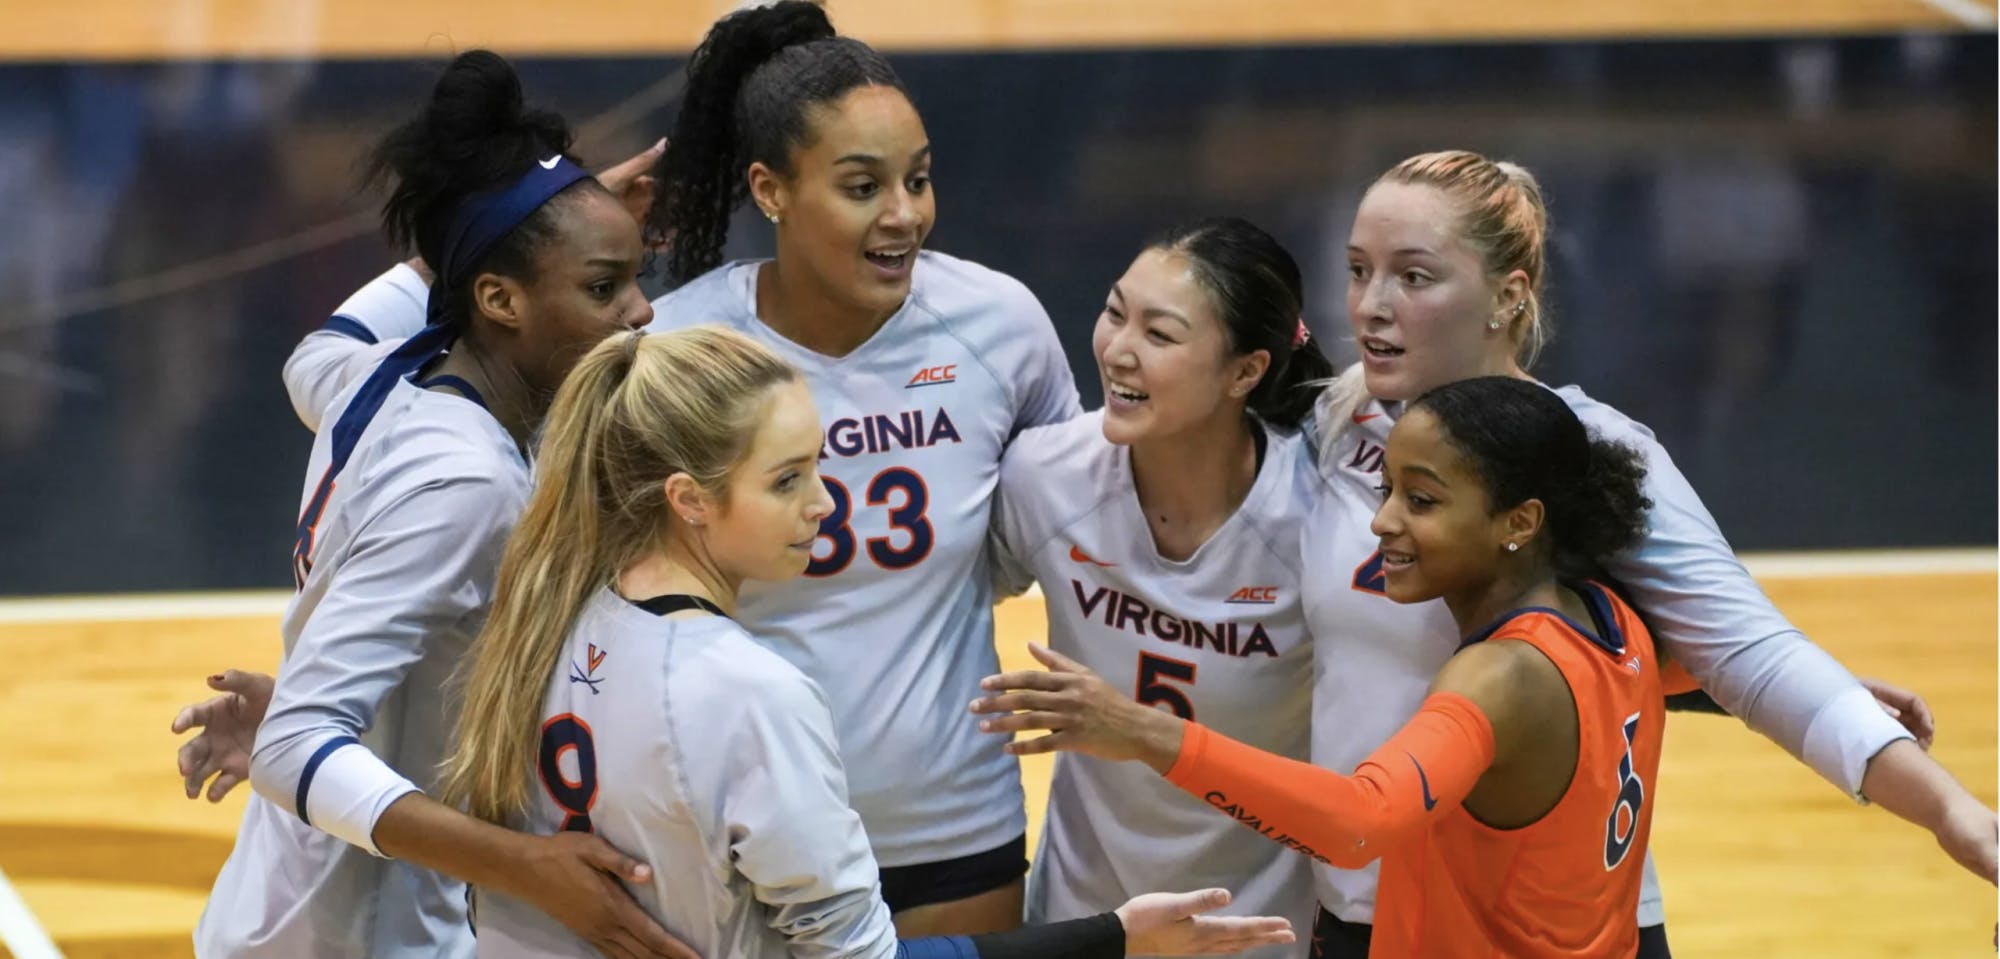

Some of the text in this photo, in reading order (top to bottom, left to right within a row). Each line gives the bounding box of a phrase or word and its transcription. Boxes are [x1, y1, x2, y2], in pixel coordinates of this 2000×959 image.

[908, 365, 957, 384] ACC
[818, 406, 962, 458] GINIA
[1072, 579, 1279, 658] VIRGINIA
[1229, 586, 1279, 601] ACC
[1136, 650, 1197, 722] 5
[1604, 711, 1644, 871] 6
